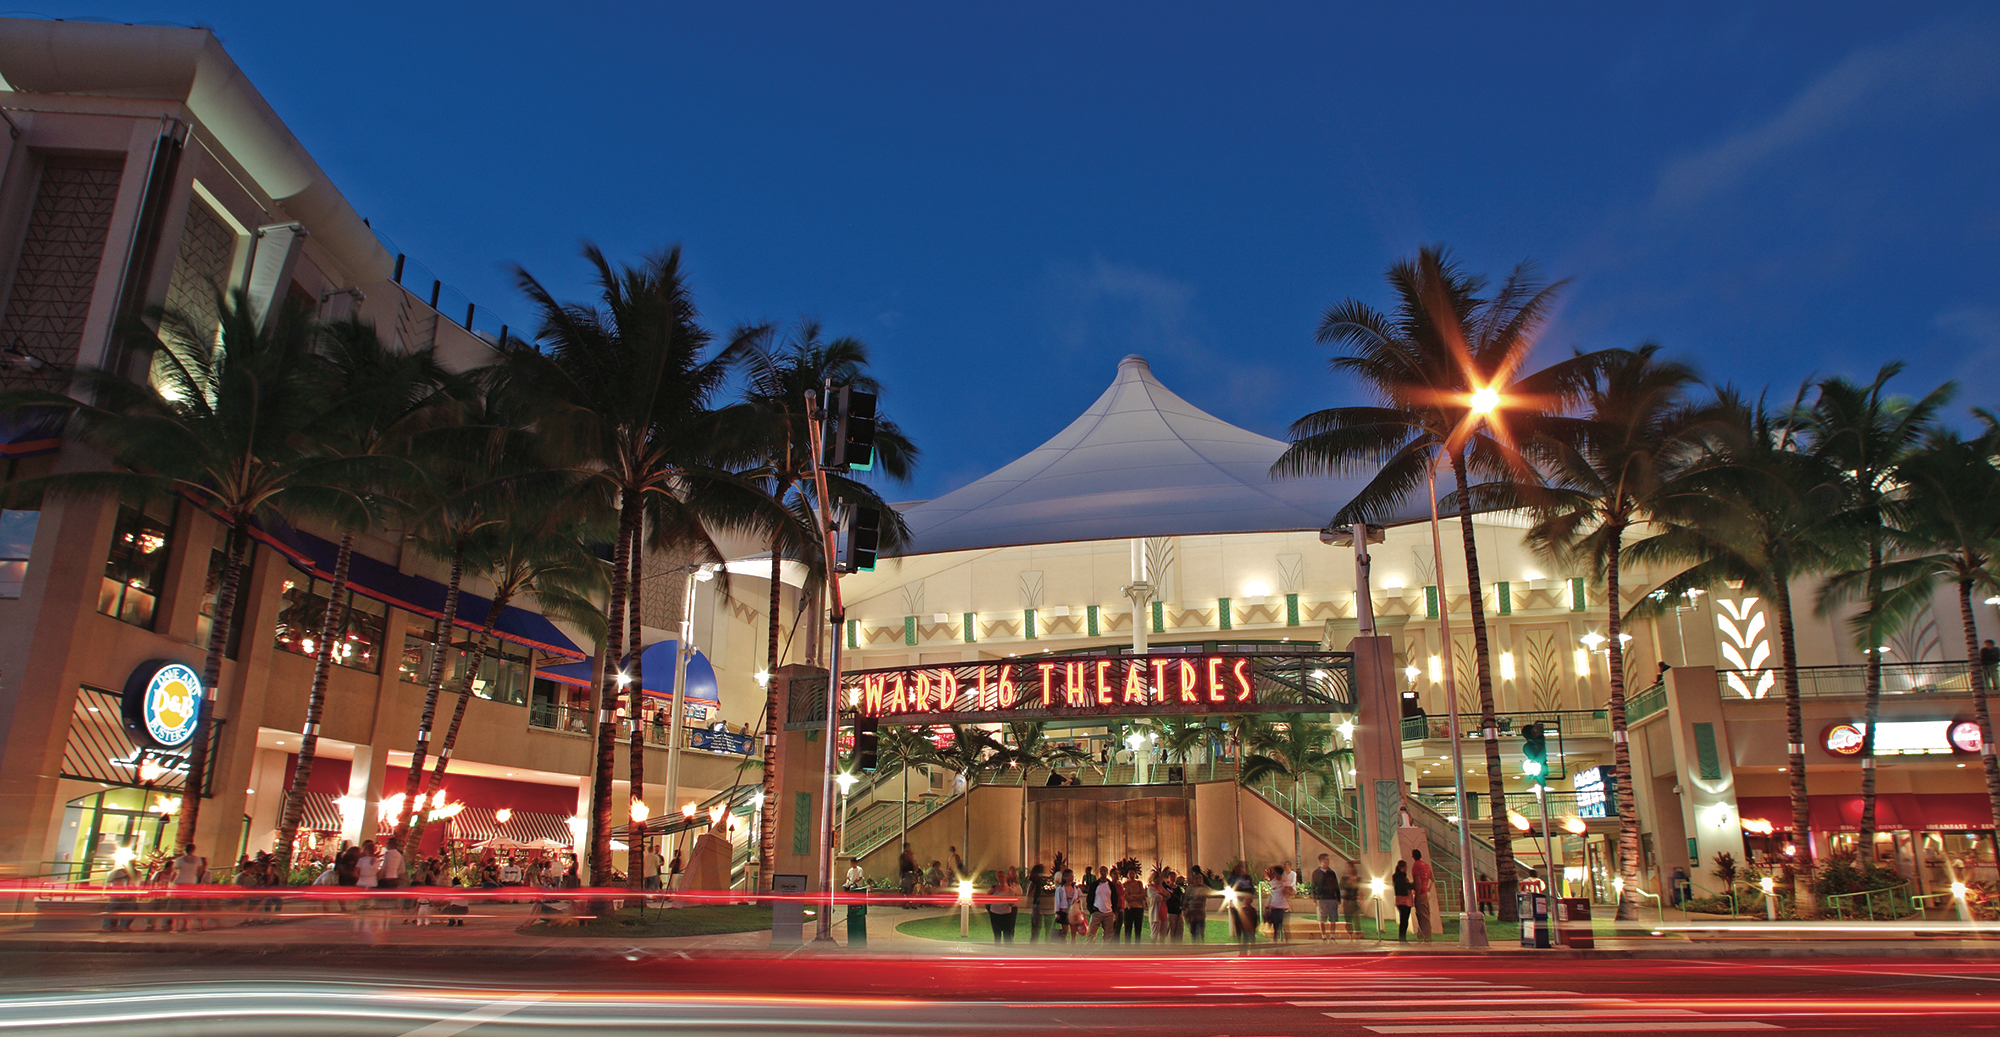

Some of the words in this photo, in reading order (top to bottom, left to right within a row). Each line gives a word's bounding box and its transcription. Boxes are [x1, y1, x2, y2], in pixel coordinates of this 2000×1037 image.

[156, 668, 180, 685] DAVE
[181, 673, 198, 696] AND
[864, 669, 957, 716] WARD
[978, 664, 1014, 708] 16
[1038, 657, 1250, 705] THEATRES
[151, 688, 195, 719] D&B
